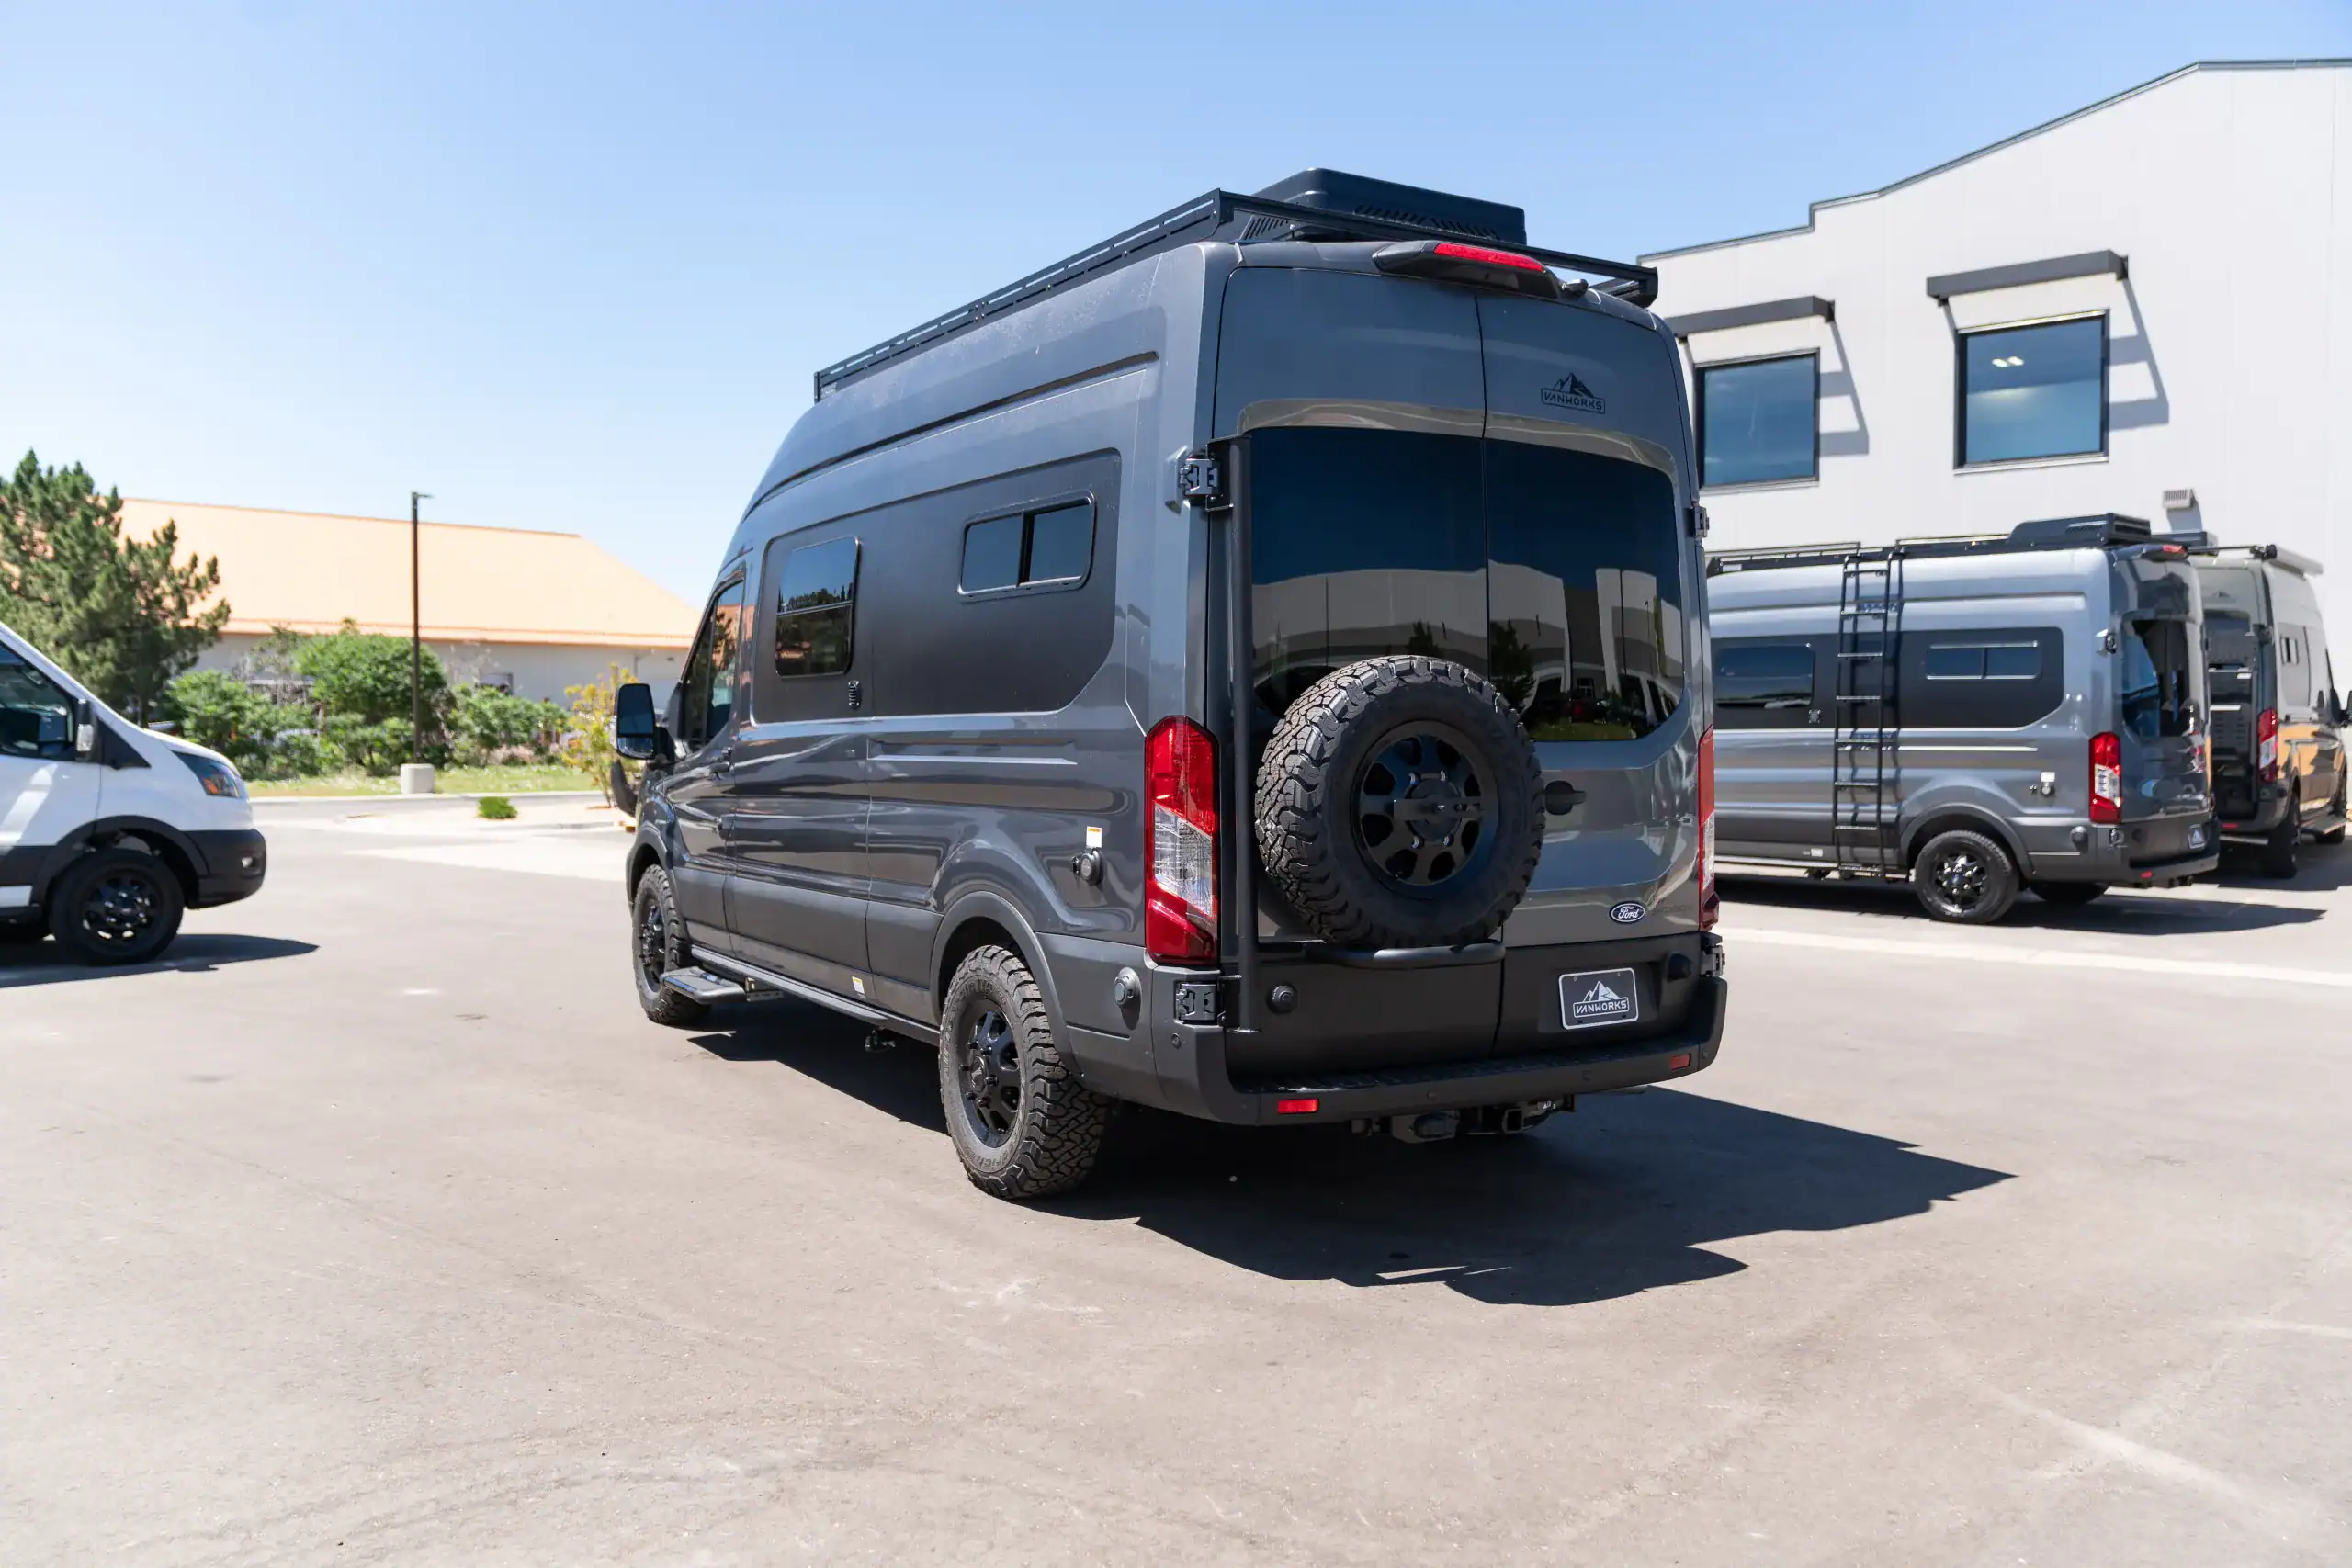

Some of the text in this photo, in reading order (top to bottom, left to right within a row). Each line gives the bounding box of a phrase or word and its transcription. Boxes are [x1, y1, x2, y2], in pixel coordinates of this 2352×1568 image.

[1544, 391, 1602, 411] VANWORKS
[1618, 906, 1639, 919] Ford
[1576, 1000, 1627, 1014] VANWORKS
